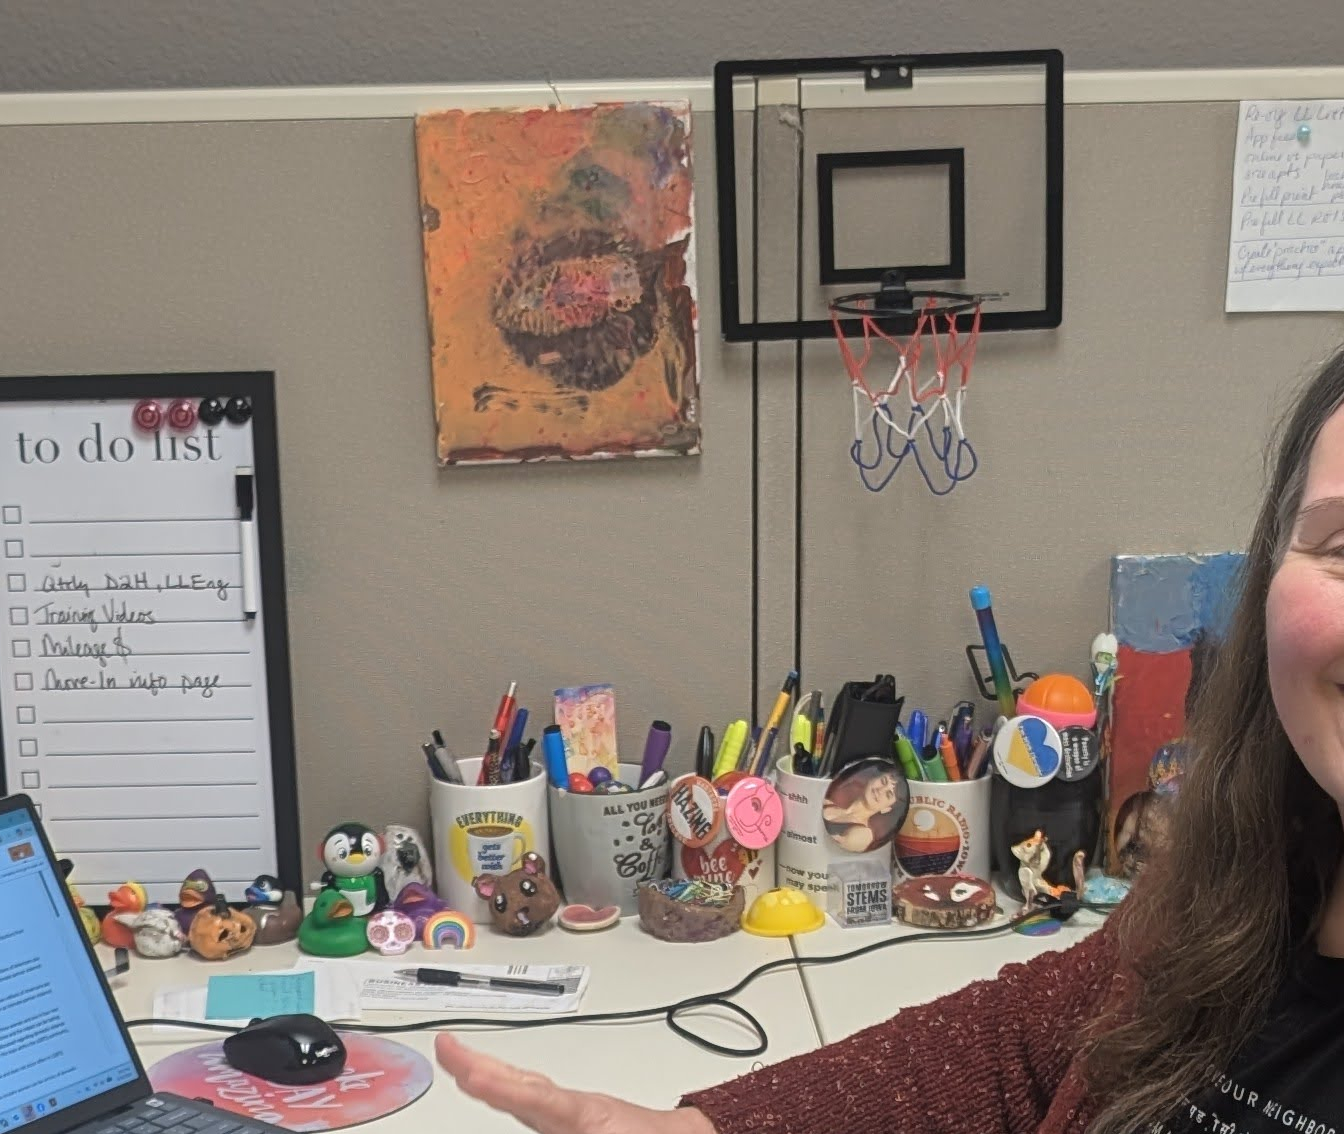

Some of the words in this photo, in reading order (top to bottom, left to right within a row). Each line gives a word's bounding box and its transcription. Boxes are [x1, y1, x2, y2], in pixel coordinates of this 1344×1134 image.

[16, 432, 61, 464] to
[78, 423, 135, 463] do
[153, 427, 223, 462] list
[34, 602, 97, 633] Training
[102, 598, 156, 624] Videos
[182, 674, 221, 698] page
[603, 803, 625, 816] ALL
[627, 800, 649, 813] YOU
[649, 796, 667, 809] NEE
[455, 810, 524, 829] EVERYTHING
[910, 795, 945, 809] UBLIC
[947, 804, 970, 840] RADIO
[786, 830, 818, 844] almost
[477, 851, 506, 863] better
[482, 843, 502, 853] gets
[613, 846, 667, 880] Coff
[699, 855, 728, 875] bee
[807, 870, 829, 882] you
[846, 881, 888, 892] TOMORROW
[846, 889, 888, 907] STEMS
